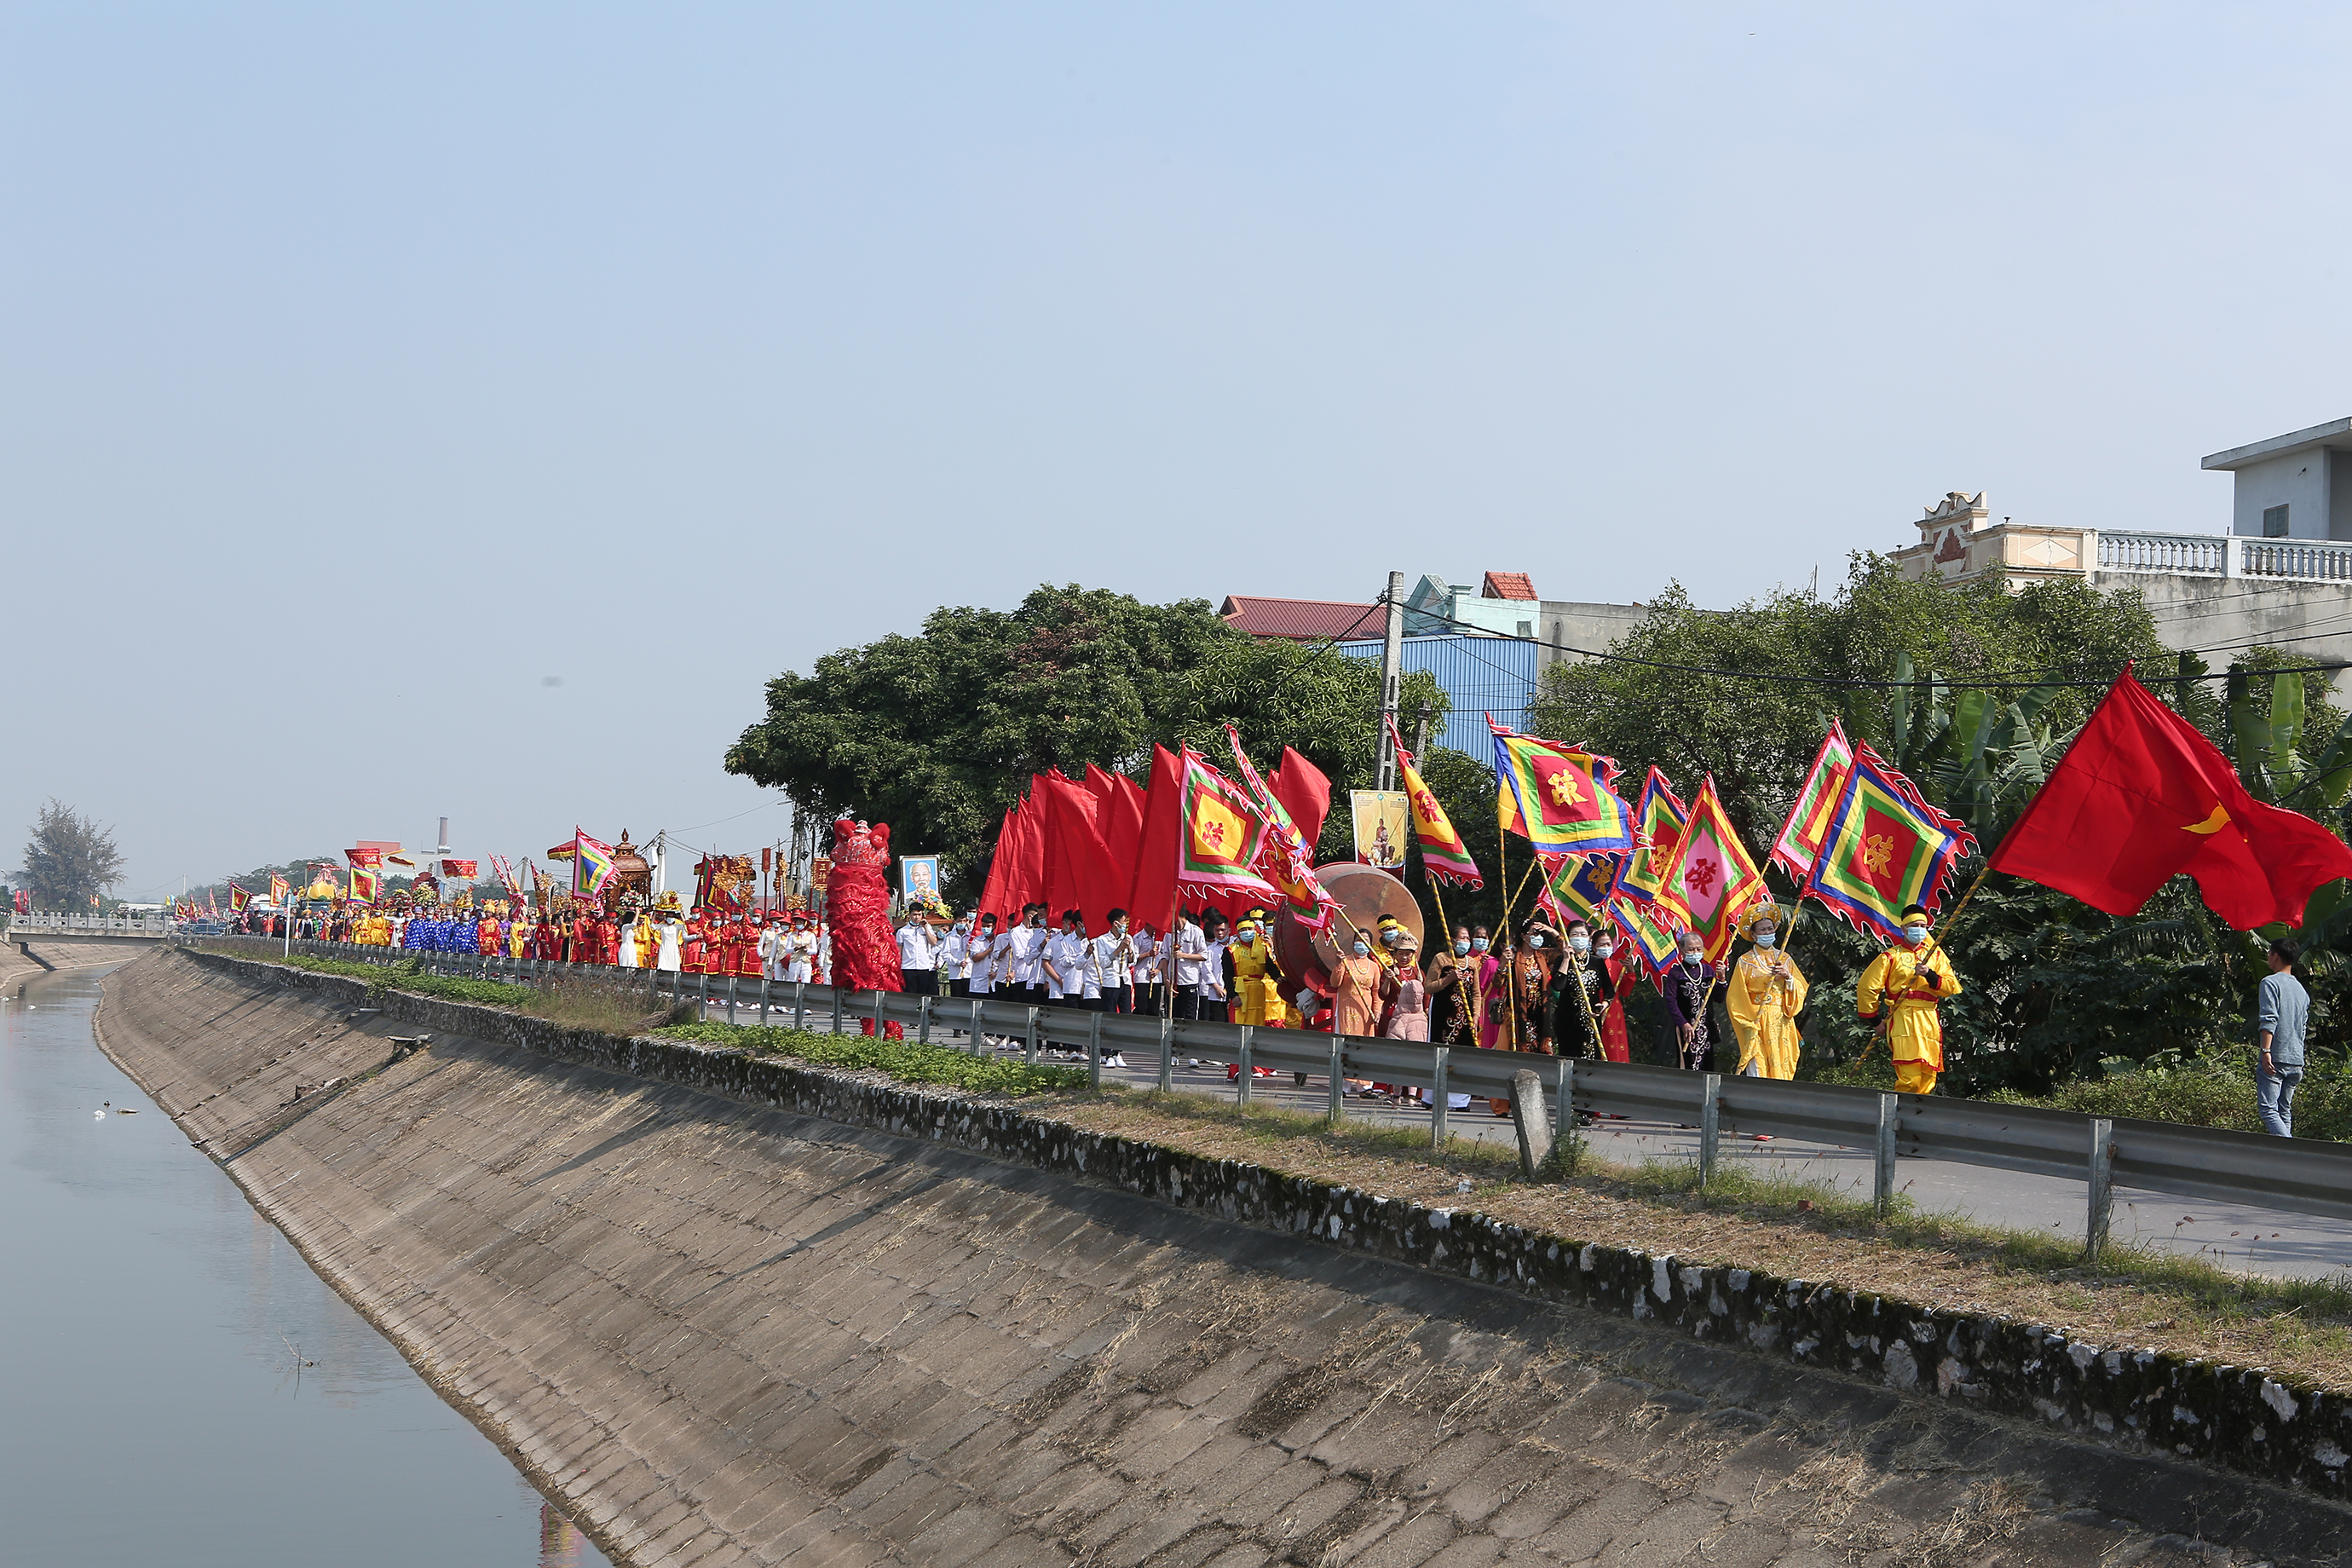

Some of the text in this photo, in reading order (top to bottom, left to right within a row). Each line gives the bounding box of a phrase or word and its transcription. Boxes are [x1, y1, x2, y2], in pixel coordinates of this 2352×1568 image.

[1548, 769, 1588, 806] 陳
[1864, 834, 1892, 879] 陳
[1686, 858, 1717, 898] 陳
